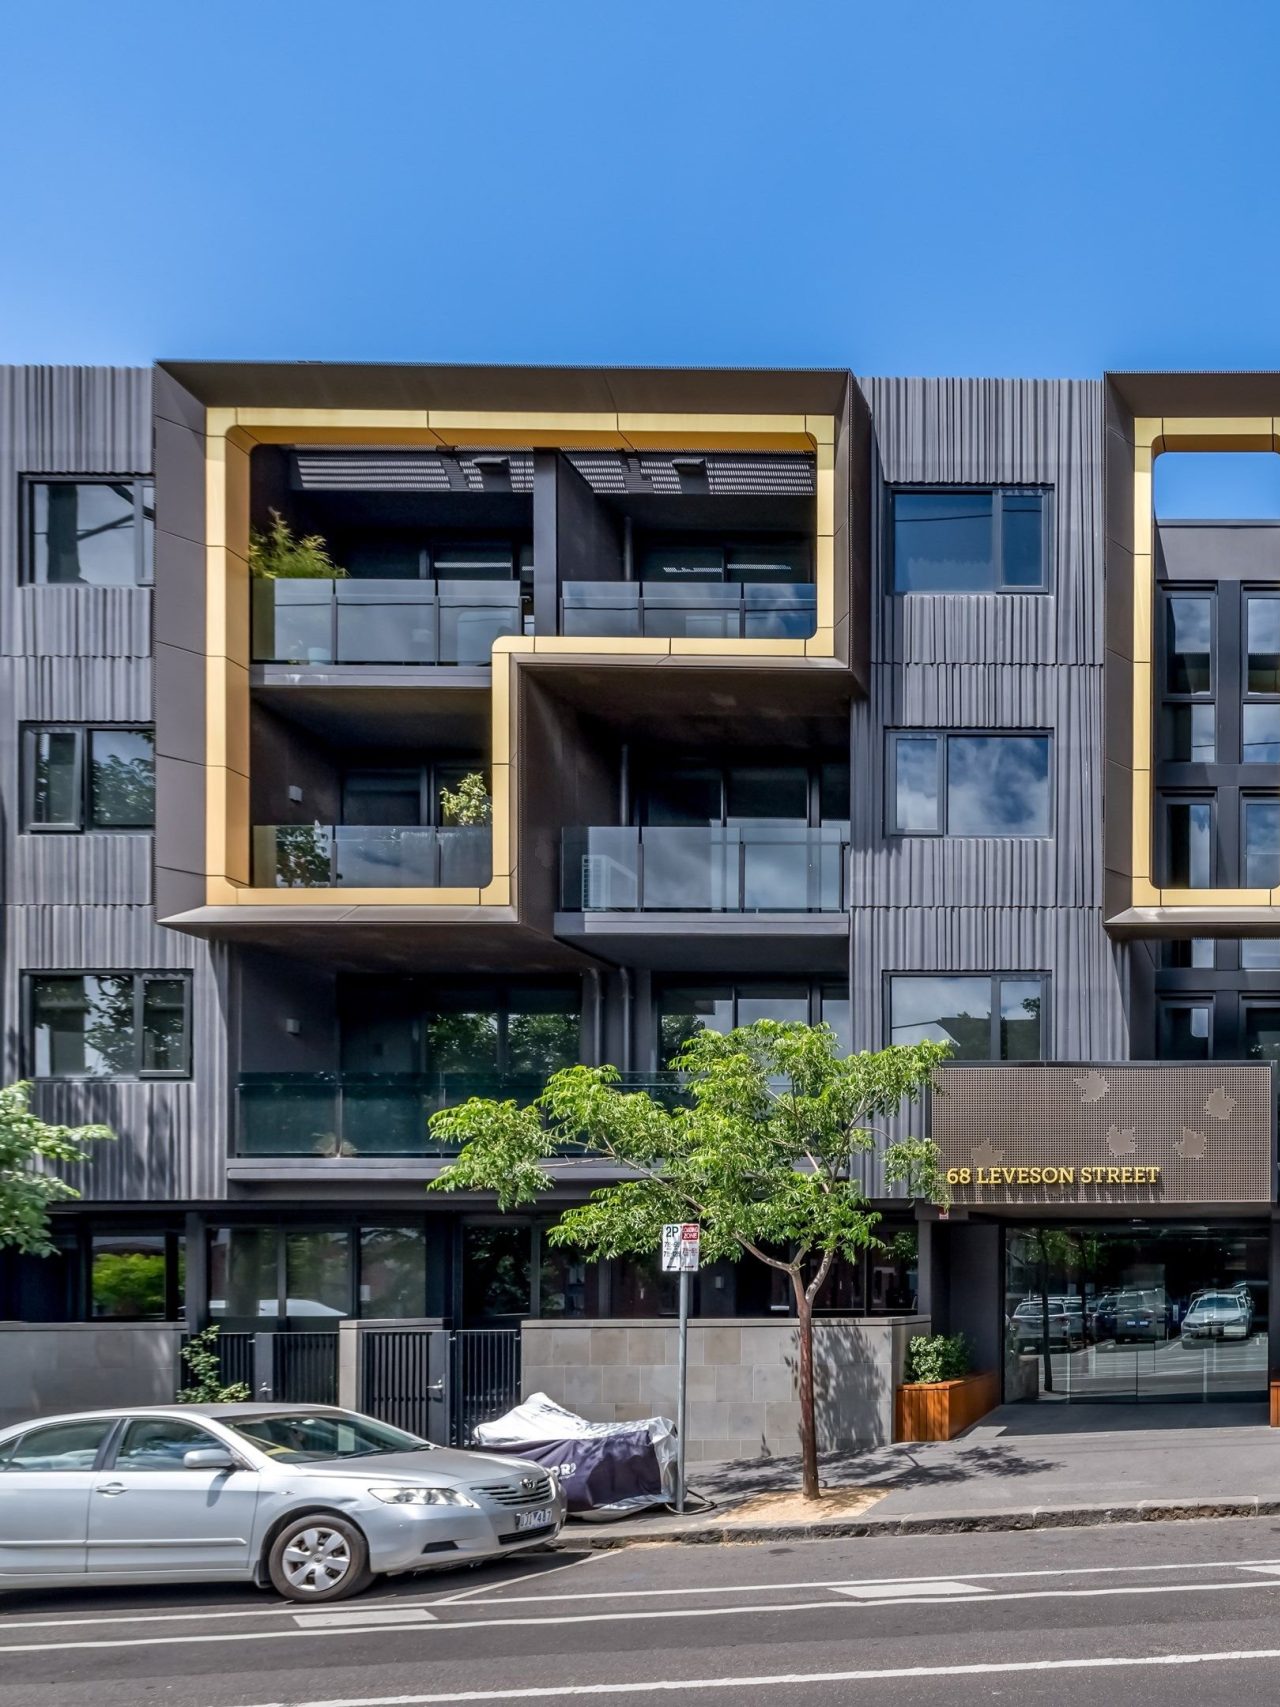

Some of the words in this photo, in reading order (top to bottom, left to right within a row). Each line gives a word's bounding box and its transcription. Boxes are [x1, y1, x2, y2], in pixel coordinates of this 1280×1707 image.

[947, 1168, 971, 1184] 68
[976, 1167, 1075, 1184] LEVESON
[1081, 1167, 1160, 1183] STREET
[666, 1226, 679, 1238] 2P
